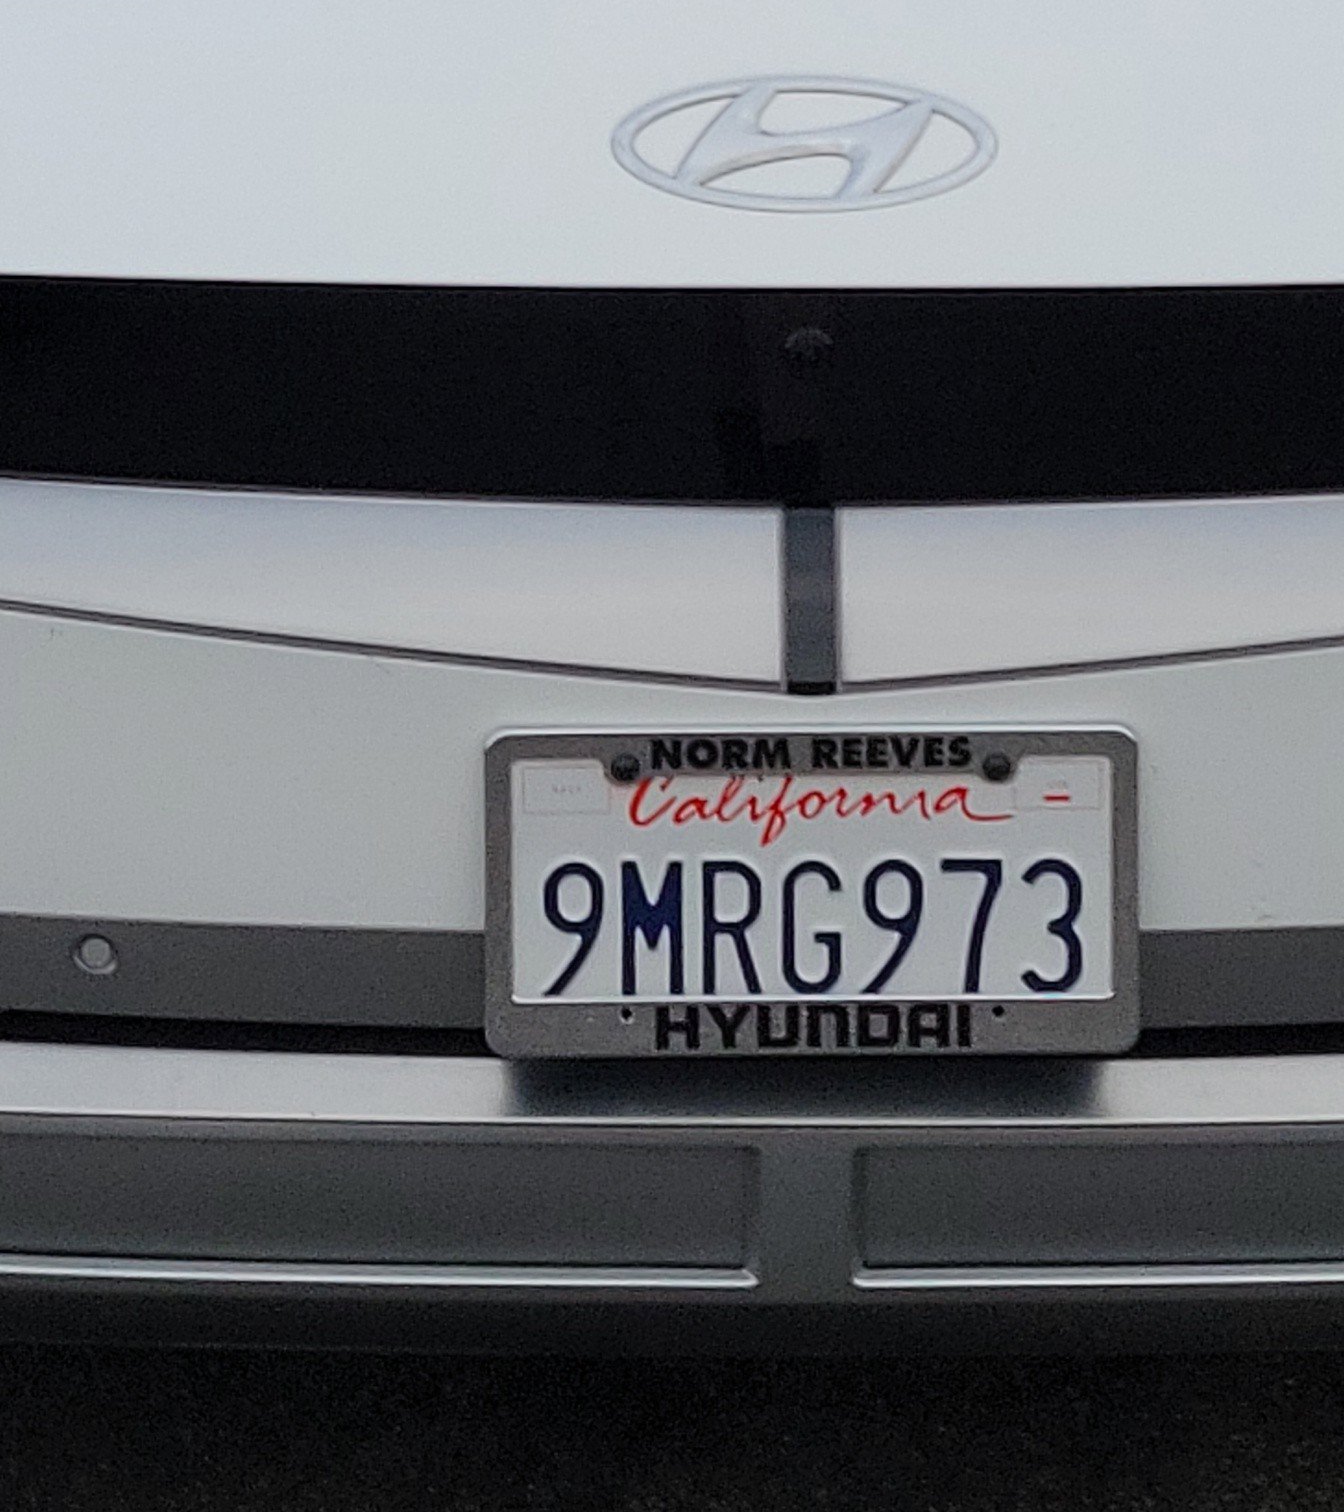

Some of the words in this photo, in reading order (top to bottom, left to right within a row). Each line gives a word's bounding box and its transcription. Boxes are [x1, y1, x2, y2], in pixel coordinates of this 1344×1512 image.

[650, 738, 791, 770] NORM
[810, 736, 973, 769] REEVES
[629, 774, 1013, 847] California
[543, 858, 1083, 996] 9MRG973
[654, 1003, 972, 1051] HYUNDAI
